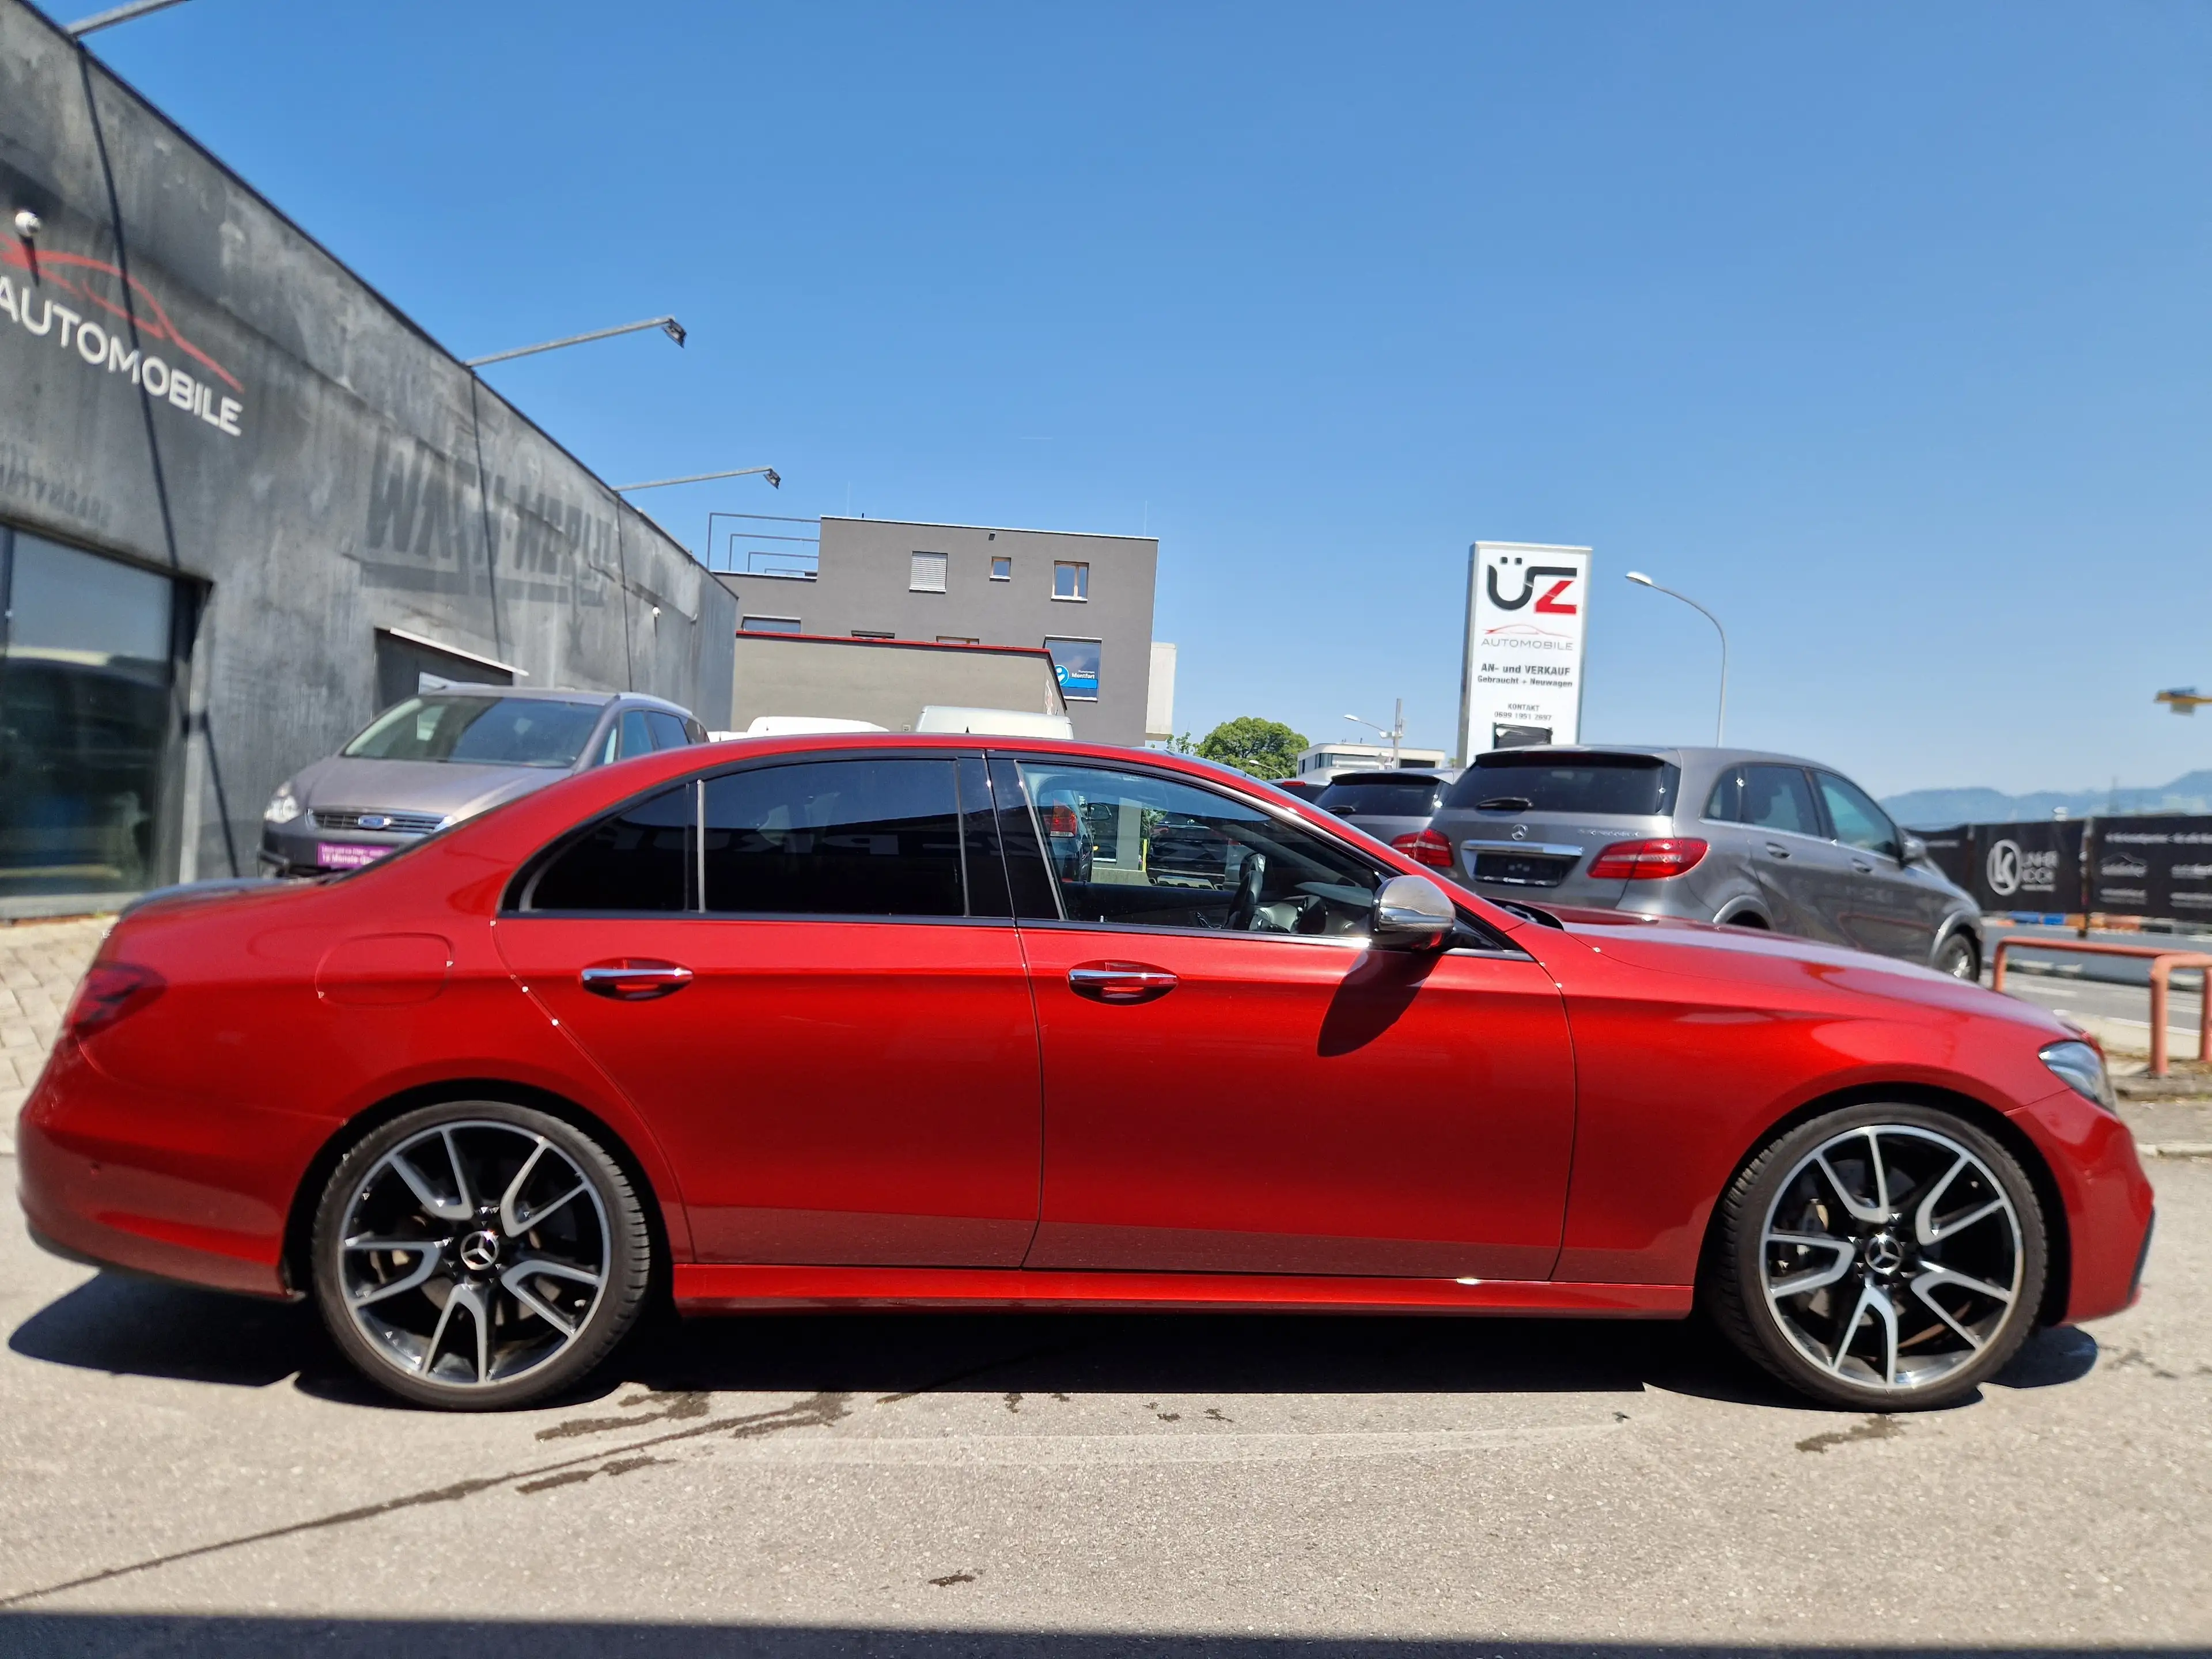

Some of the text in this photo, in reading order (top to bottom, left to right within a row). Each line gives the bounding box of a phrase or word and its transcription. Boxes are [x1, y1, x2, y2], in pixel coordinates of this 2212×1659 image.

[0, 275, 243, 436] AUTOMOBILE
[1481, 638, 1573, 651] AUTOMOBILE
[1481, 663, 1570, 676] AN- und VERKAUF
[1478, 675, 1518, 684] Gebraucht
[1530, 678, 1573, 688] Neuwagen
[1508, 703, 1540, 711] KONTAKT
